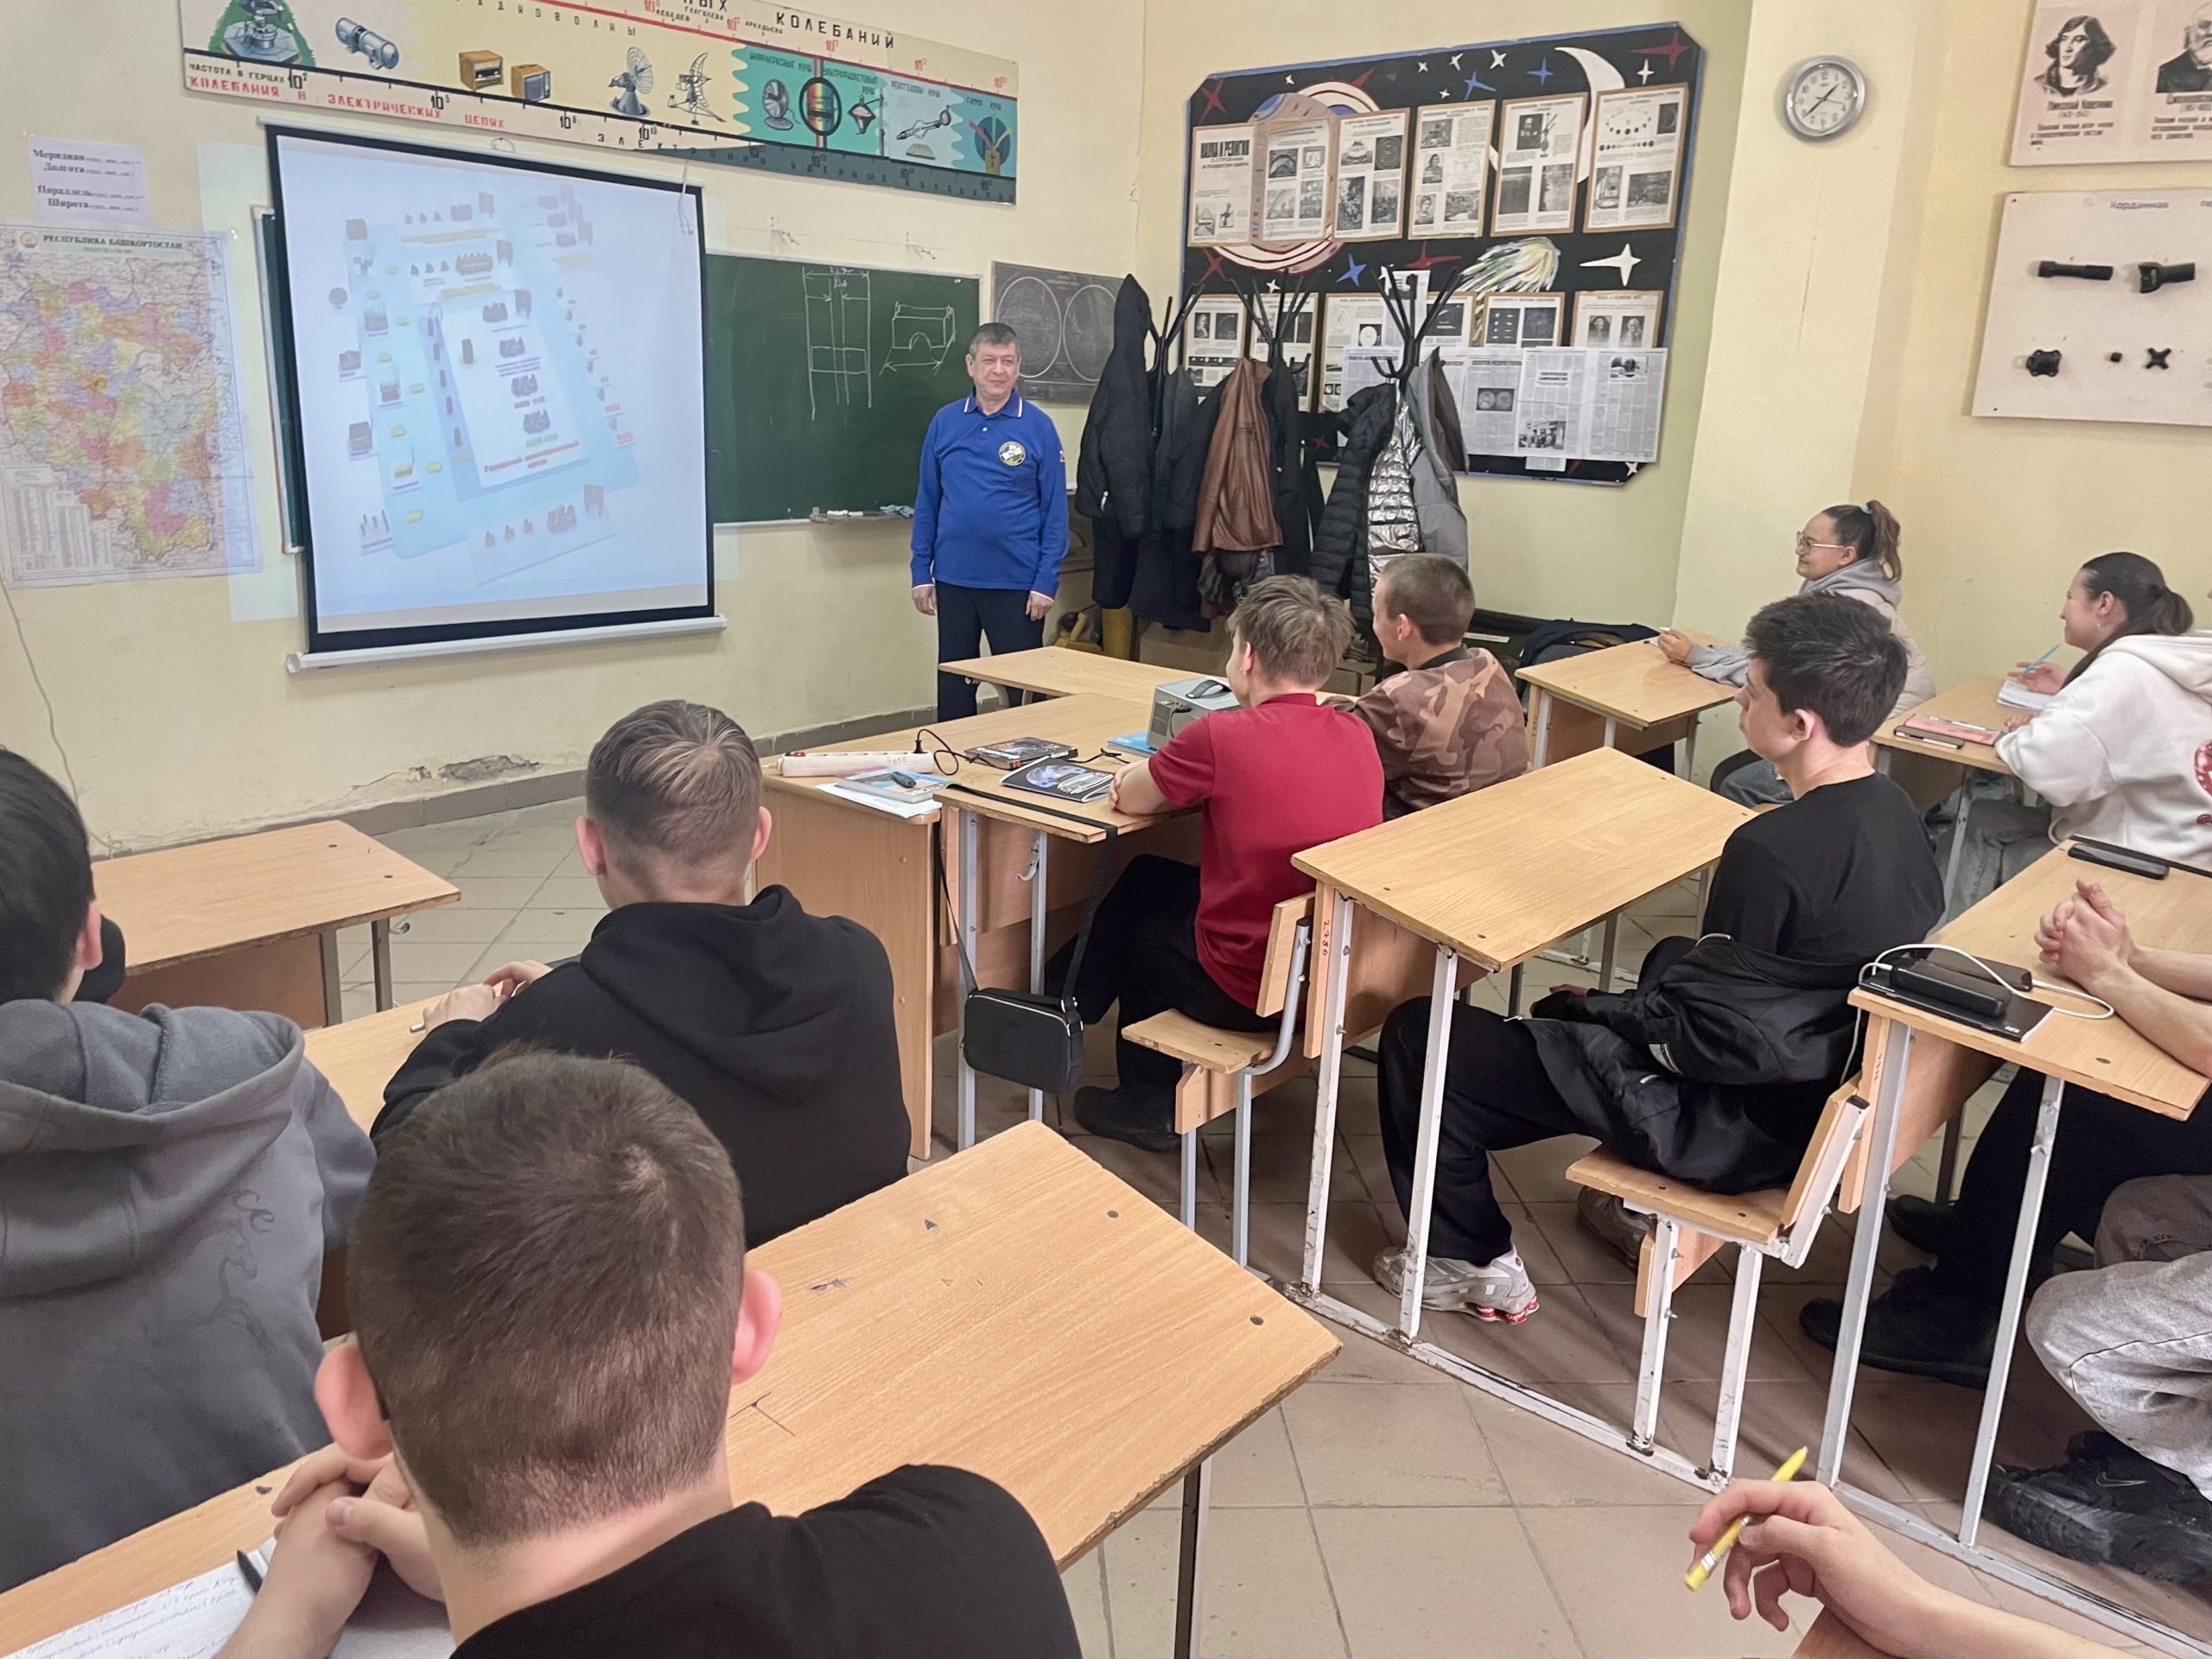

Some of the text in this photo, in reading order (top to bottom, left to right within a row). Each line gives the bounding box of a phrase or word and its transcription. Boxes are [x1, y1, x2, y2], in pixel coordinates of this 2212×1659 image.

[456, 0, 636, 36] АДИОВОЛНЫ
[683, 0, 896, 49] ЫХ КОЛЕБАНИЙ
[188, 62, 232, 76] ЧАСТОТА
[249, 72, 284, 83] ГЕРЦАХ
[188, 76, 280, 98] КОЛЕБАНИЯ
[327, 93, 442, 119] ЭЛЕКТРИЧЕСКИХ
[464, 113, 505, 129] ЦЕПЯХ
